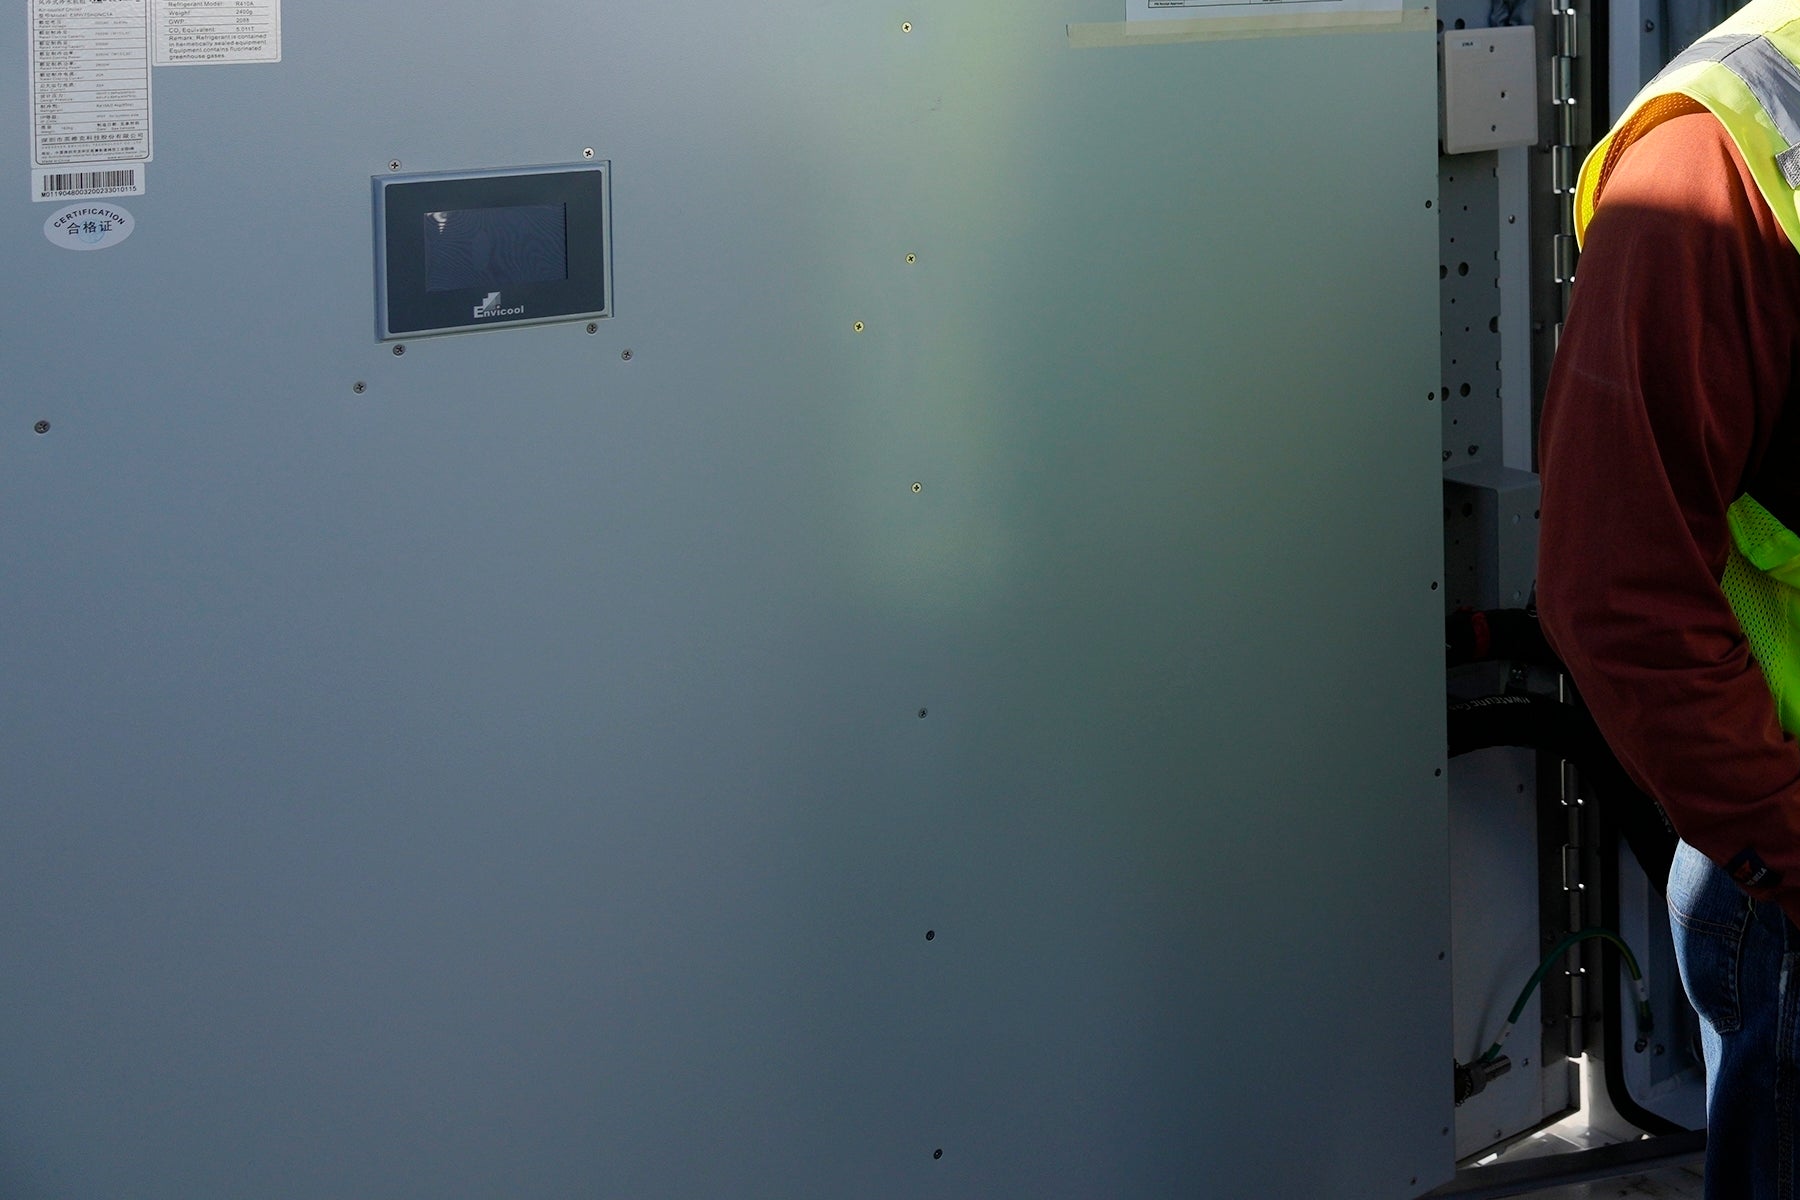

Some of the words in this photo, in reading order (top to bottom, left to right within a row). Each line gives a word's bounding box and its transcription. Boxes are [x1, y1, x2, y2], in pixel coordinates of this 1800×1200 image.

[54, 208, 125, 228] CERTIFICATION
[67, 220, 113, 235] 合格证
[474, 305, 524, 318] Envicool
